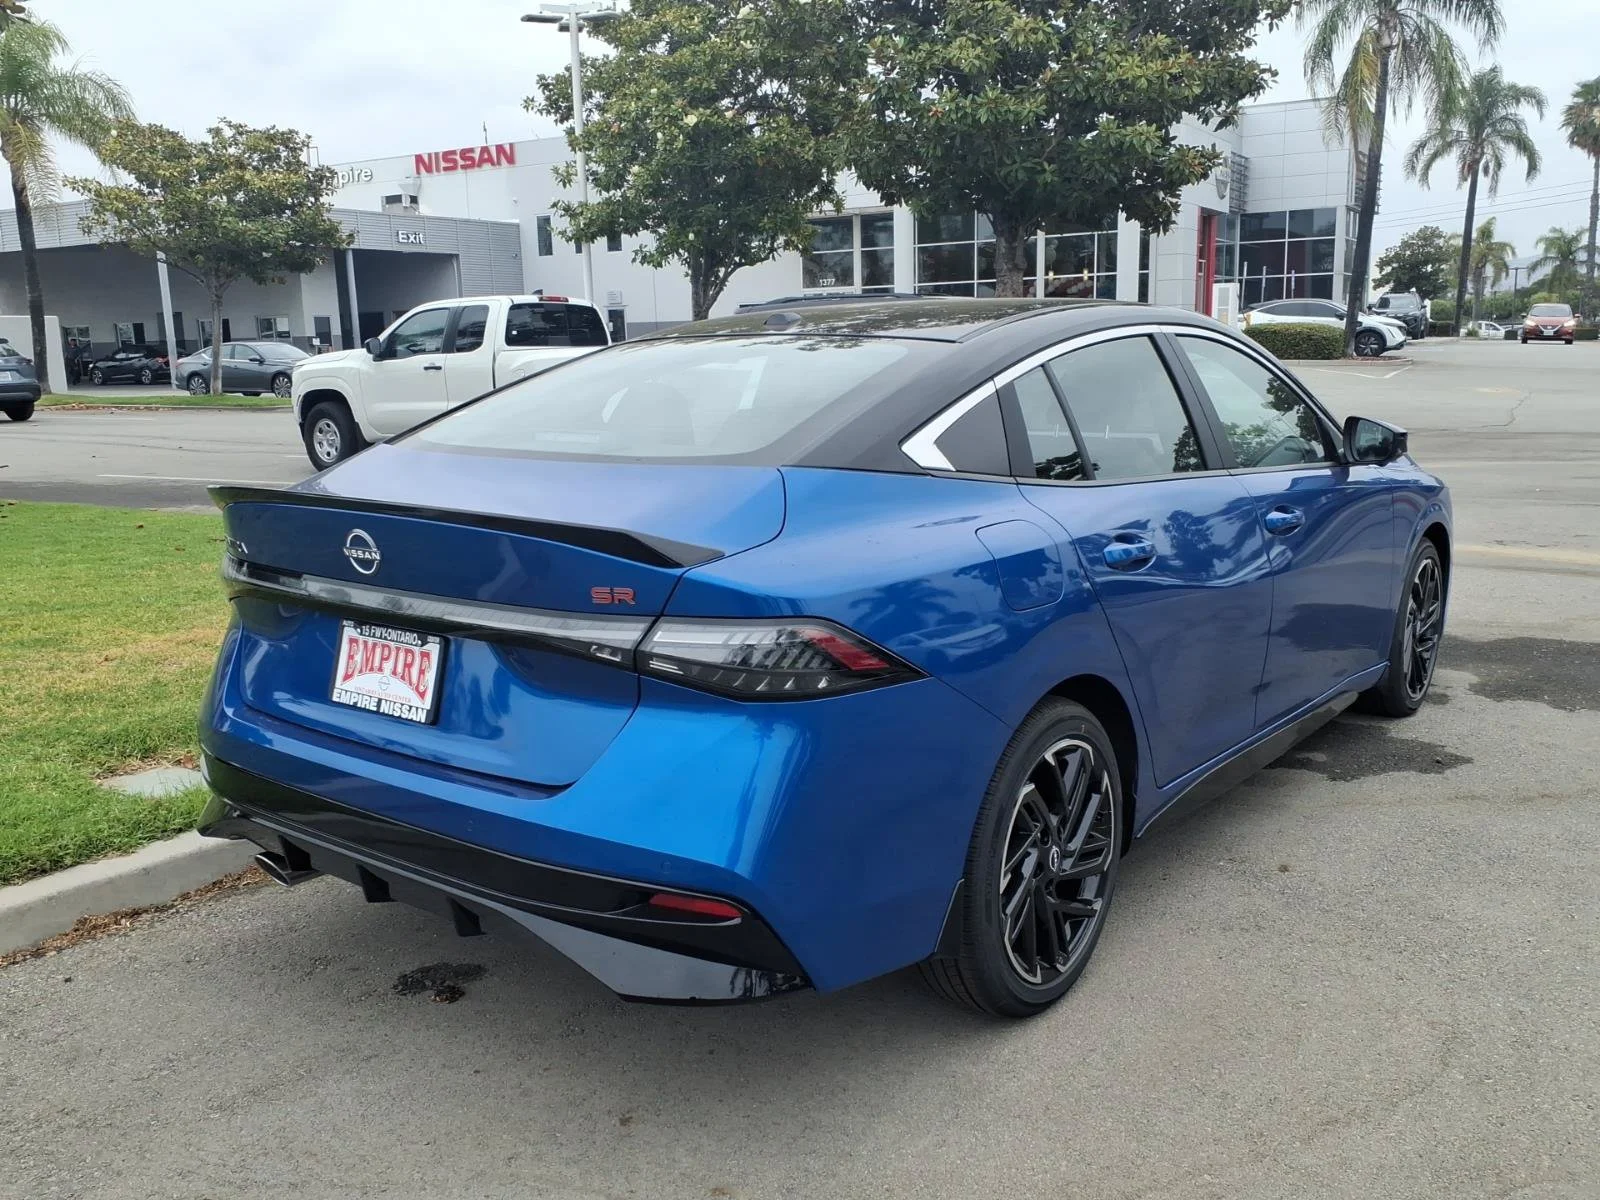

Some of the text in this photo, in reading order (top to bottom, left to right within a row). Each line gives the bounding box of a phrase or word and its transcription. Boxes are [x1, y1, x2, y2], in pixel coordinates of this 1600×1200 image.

[414, 143, 516, 175] NISSAN
[398, 230, 424, 245] Exit
[591, 586, 636, 605] SR
[361, 625, 370, 635] 15
[341, 635, 433, 704] EMPIRE
[332, 688, 378, 711] EMPIRE
[380, 701, 427, 723] NISSAN
